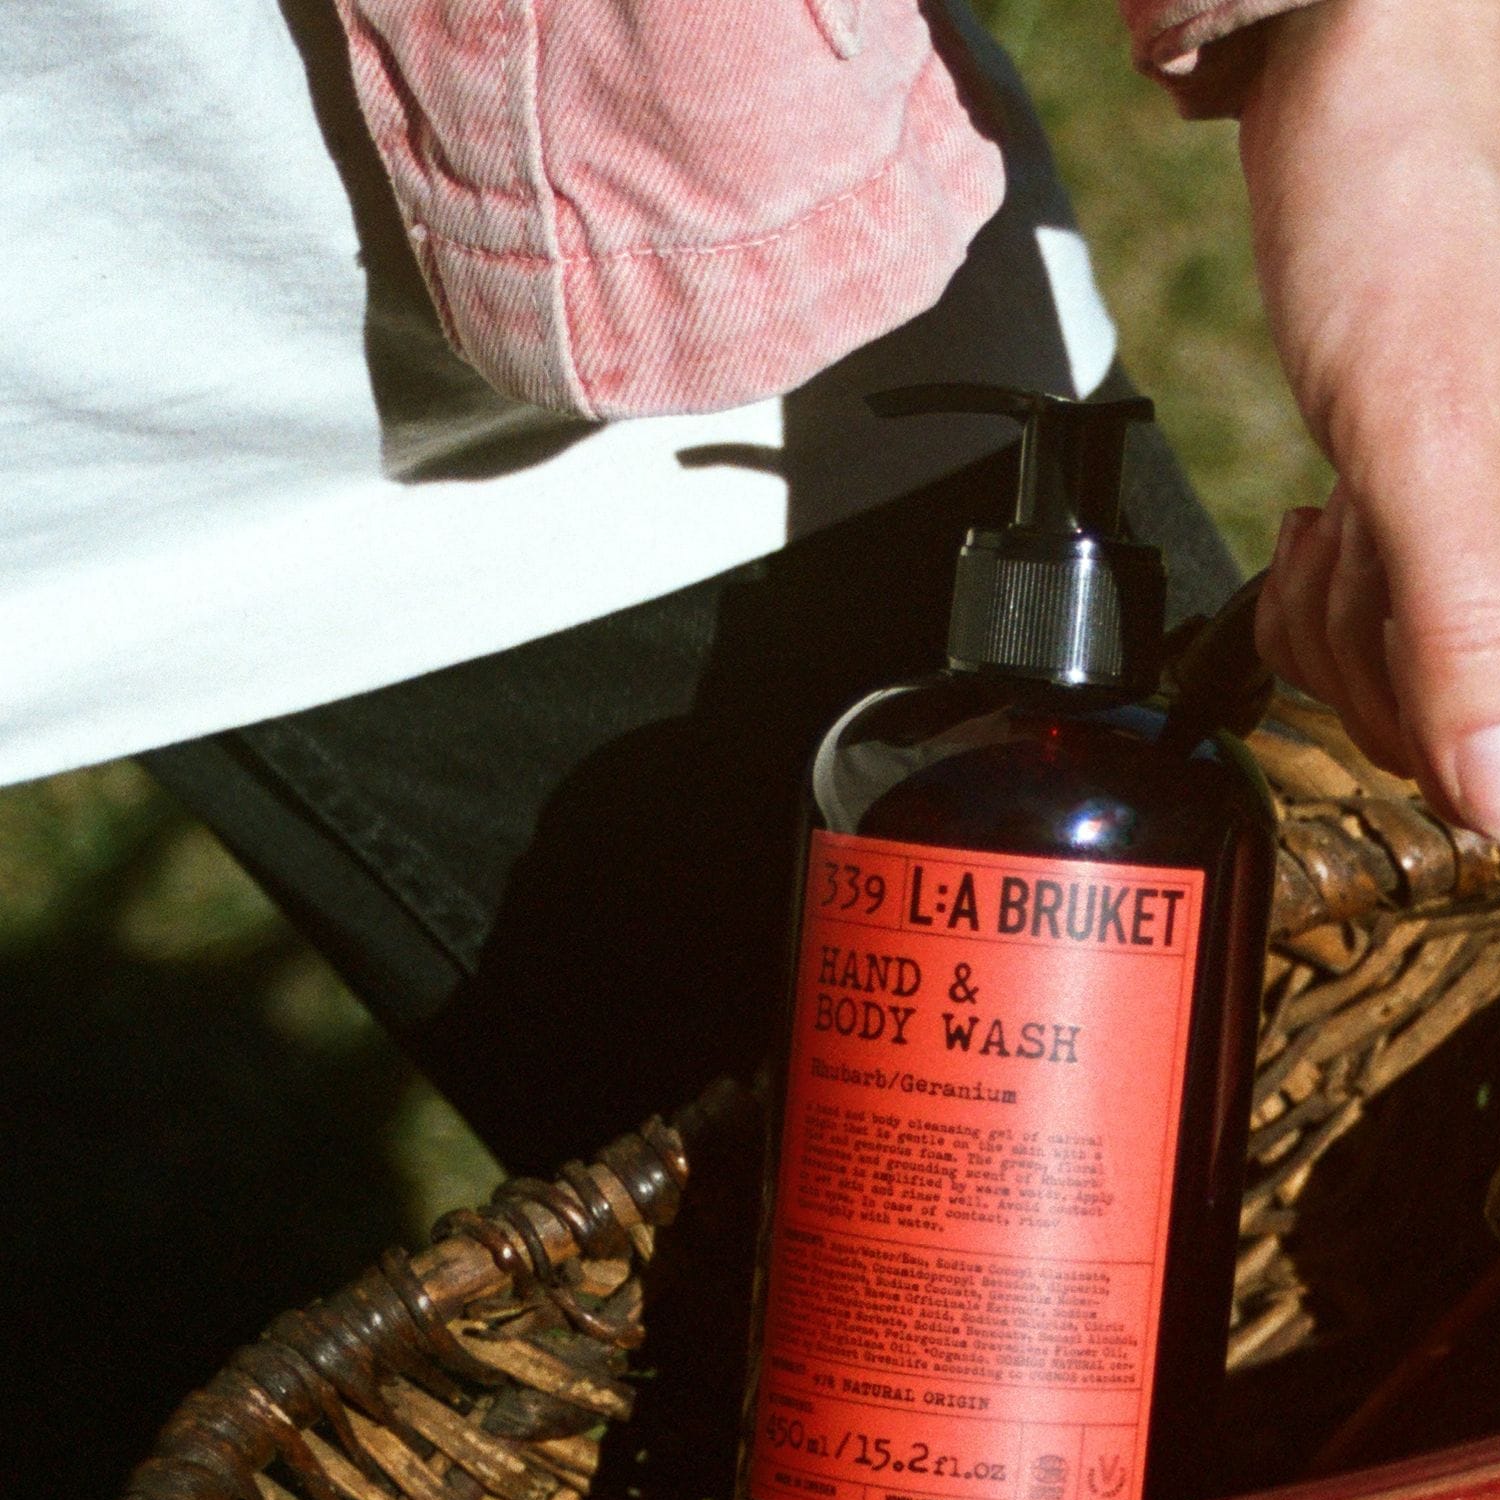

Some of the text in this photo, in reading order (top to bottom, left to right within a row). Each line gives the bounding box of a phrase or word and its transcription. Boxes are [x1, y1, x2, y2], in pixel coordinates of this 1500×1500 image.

[819, 860, 887, 916] 339
[908, 864, 1185, 950] L:A BRUKET
[816, 944, 980, 1004] HAND &
[813, 992, 1082, 1064] BODY WASH
[809, 1056, 1018, 1104] Rhubarb/Geranium
[870, 1111, 901, 1129] body
[907, 1118, 980, 1140] cleansing
[988, 1126, 1012, 1142] gel
[1022, 1130, 1038, 1142] of
[875, 1126, 890, 1140] is
[896, 1131, 944, 1147] gentle
[952, 1139, 969, 1149] on
[853, 1139, 912, 1157] generous
[920, 1147, 958, 1162] foam.
[966, 1152, 992, 1165] The
[872, 1170, 942, 1190] amplified
[950, 1180, 966, 1194] by
[886, 1158, 958, 1178] grounding
[964, 1168, 1006, 1182] scent
[900, 1186, 940, 1202] rinse
[859, 1210, 946, 1232] with water.
[882, 1200, 913, 1212] case
[920, 1204, 936, 1216] of
[944, 1208, 1010, 1226] contact,
[842, 1378, 916, 1402] NATURAL
[922, 1390, 991, 1412] ORIGIN
[764, 1412, 1008, 1484] 450ml/15.2fl.oz
